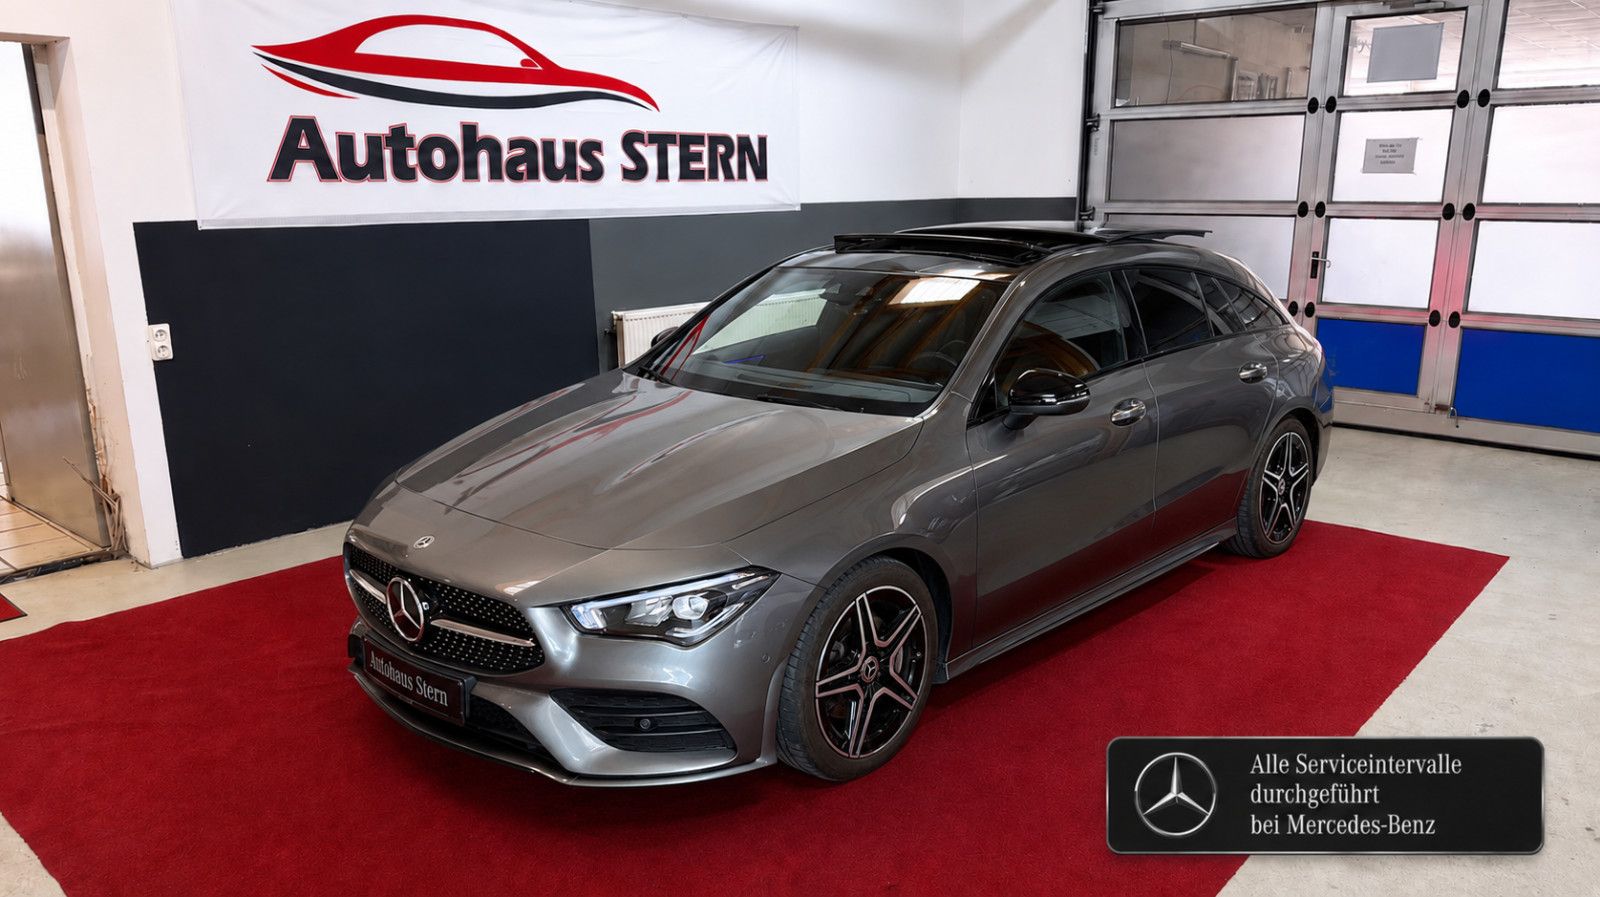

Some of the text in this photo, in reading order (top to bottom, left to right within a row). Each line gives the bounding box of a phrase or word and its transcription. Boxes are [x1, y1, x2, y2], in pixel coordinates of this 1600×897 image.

[267, 115, 768, 184] Autohaus STERN
[369, 651, 449, 707] Autohaus Stern
